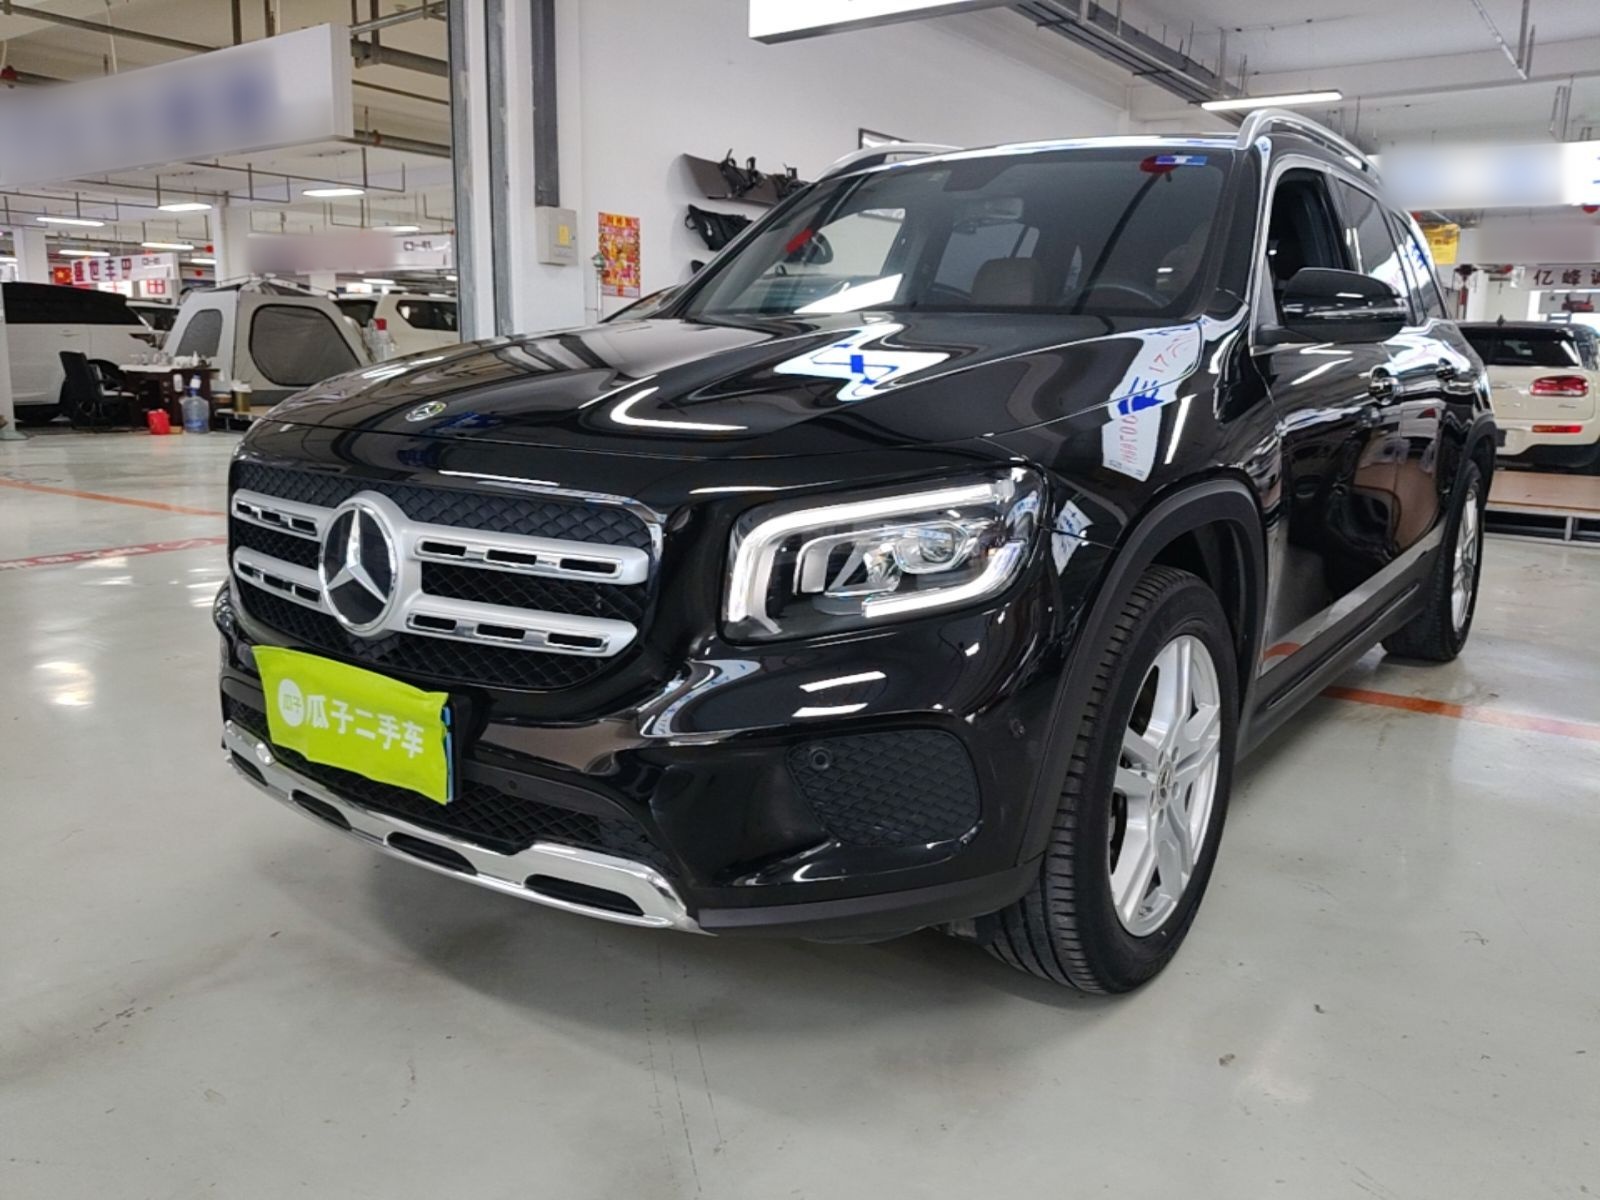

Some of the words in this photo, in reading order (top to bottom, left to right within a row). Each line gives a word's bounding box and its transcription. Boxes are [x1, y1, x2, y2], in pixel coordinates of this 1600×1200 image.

[305, 694, 424, 759] 瓜子二手车
